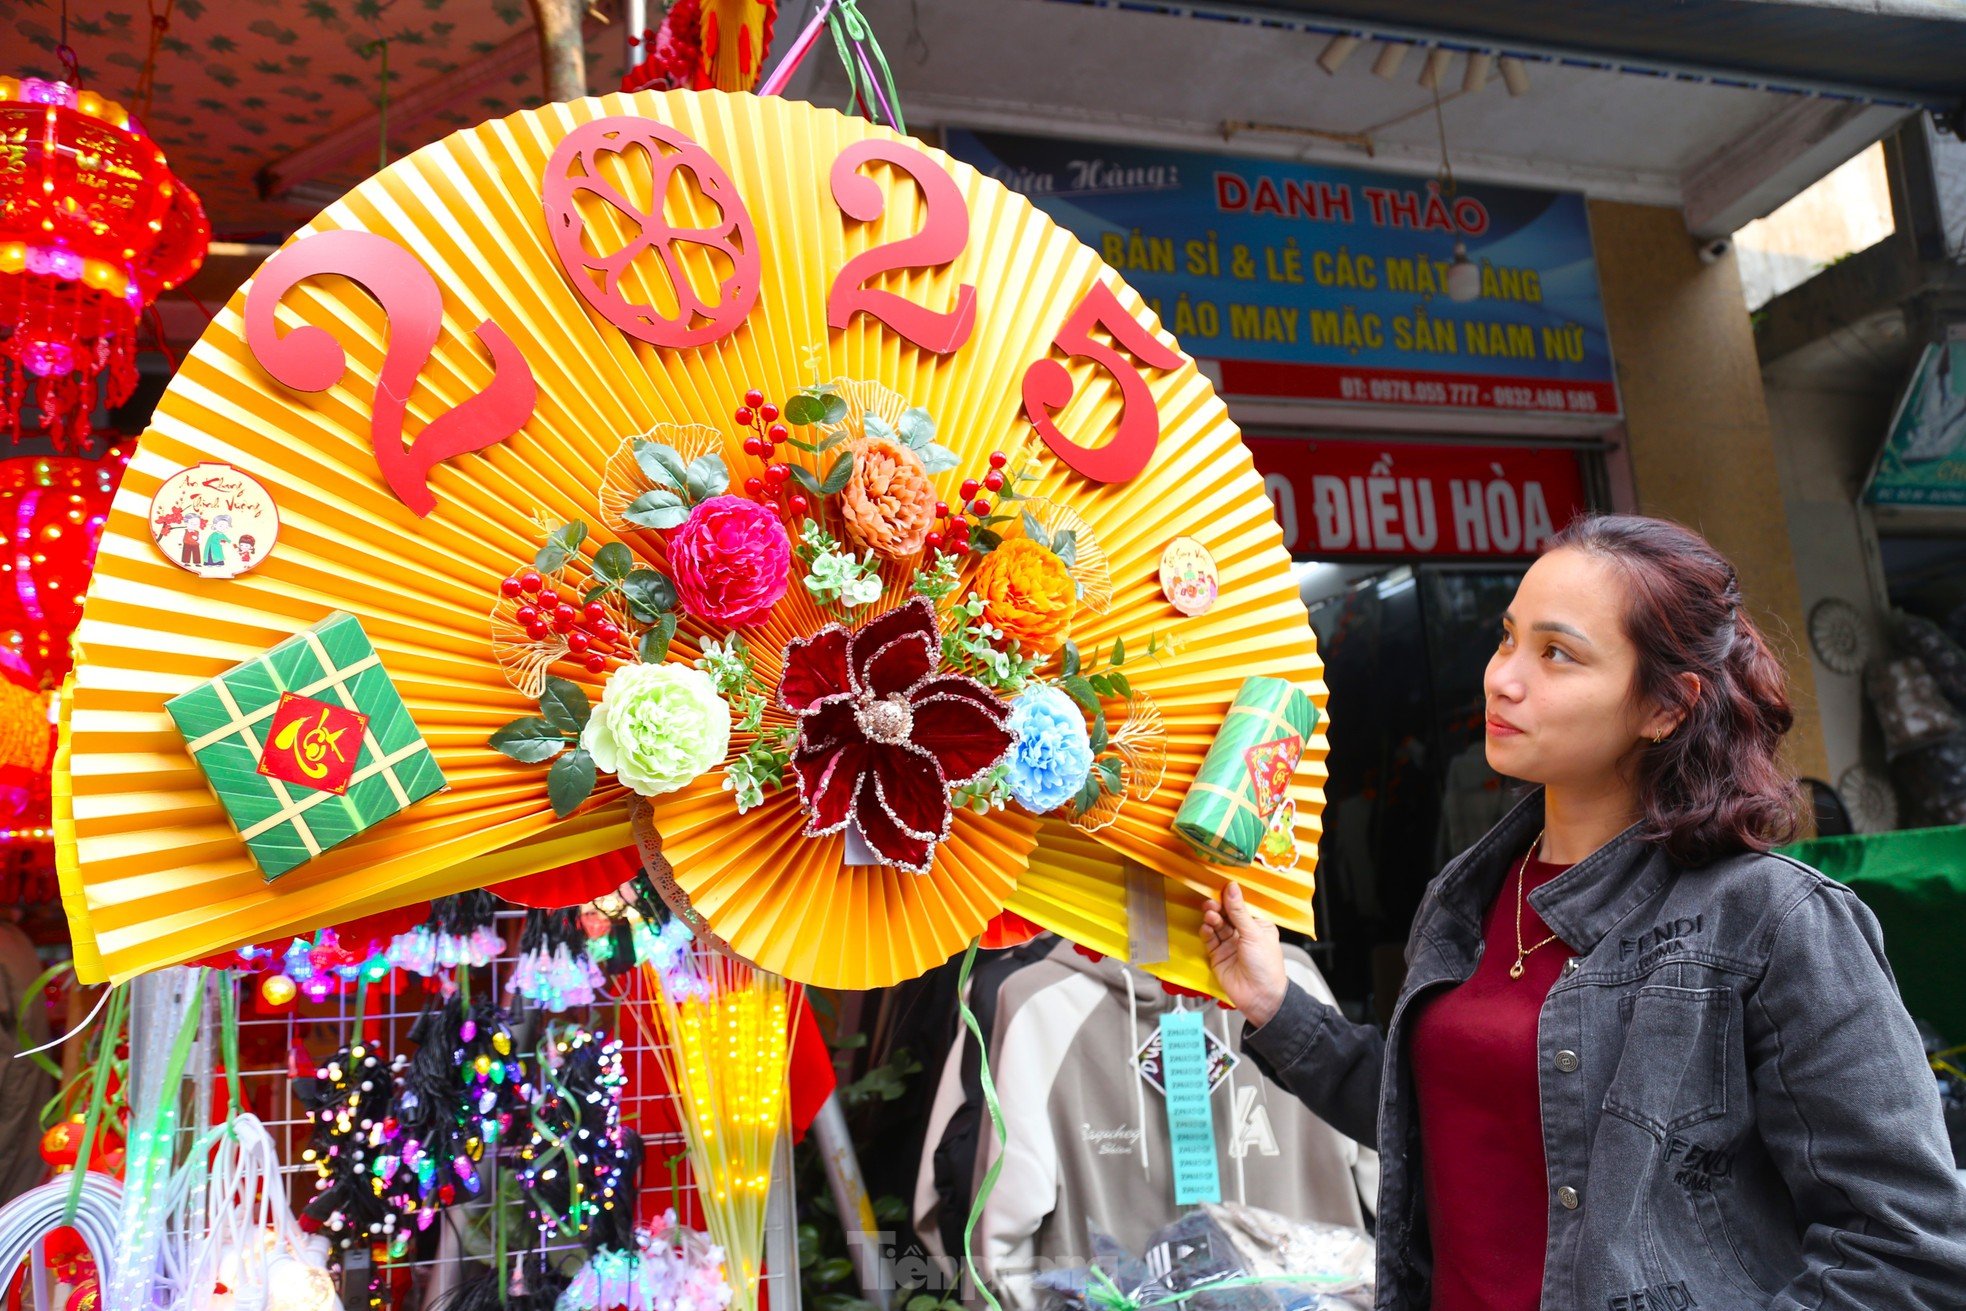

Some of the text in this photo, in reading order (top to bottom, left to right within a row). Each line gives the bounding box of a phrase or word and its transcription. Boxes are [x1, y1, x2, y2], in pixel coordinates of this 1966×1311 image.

[1213, 171, 1490, 237] DANH THẢO
[1102, 228, 1543, 302] BÁN SỈ & LẺ CÁC MẶT ÀNG
[1175, 292, 1220, 339] ÁO
[1229, 303, 1298, 344] MAY
[1310, 304, 1384, 356] MẶC
[1464, 320, 1536, 361] NAM
[1312, 453, 1438, 550] ĐIỀU
[1449, 461, 1555, 551] HÒA
[1619, 913, 1703, 962] FENDI
